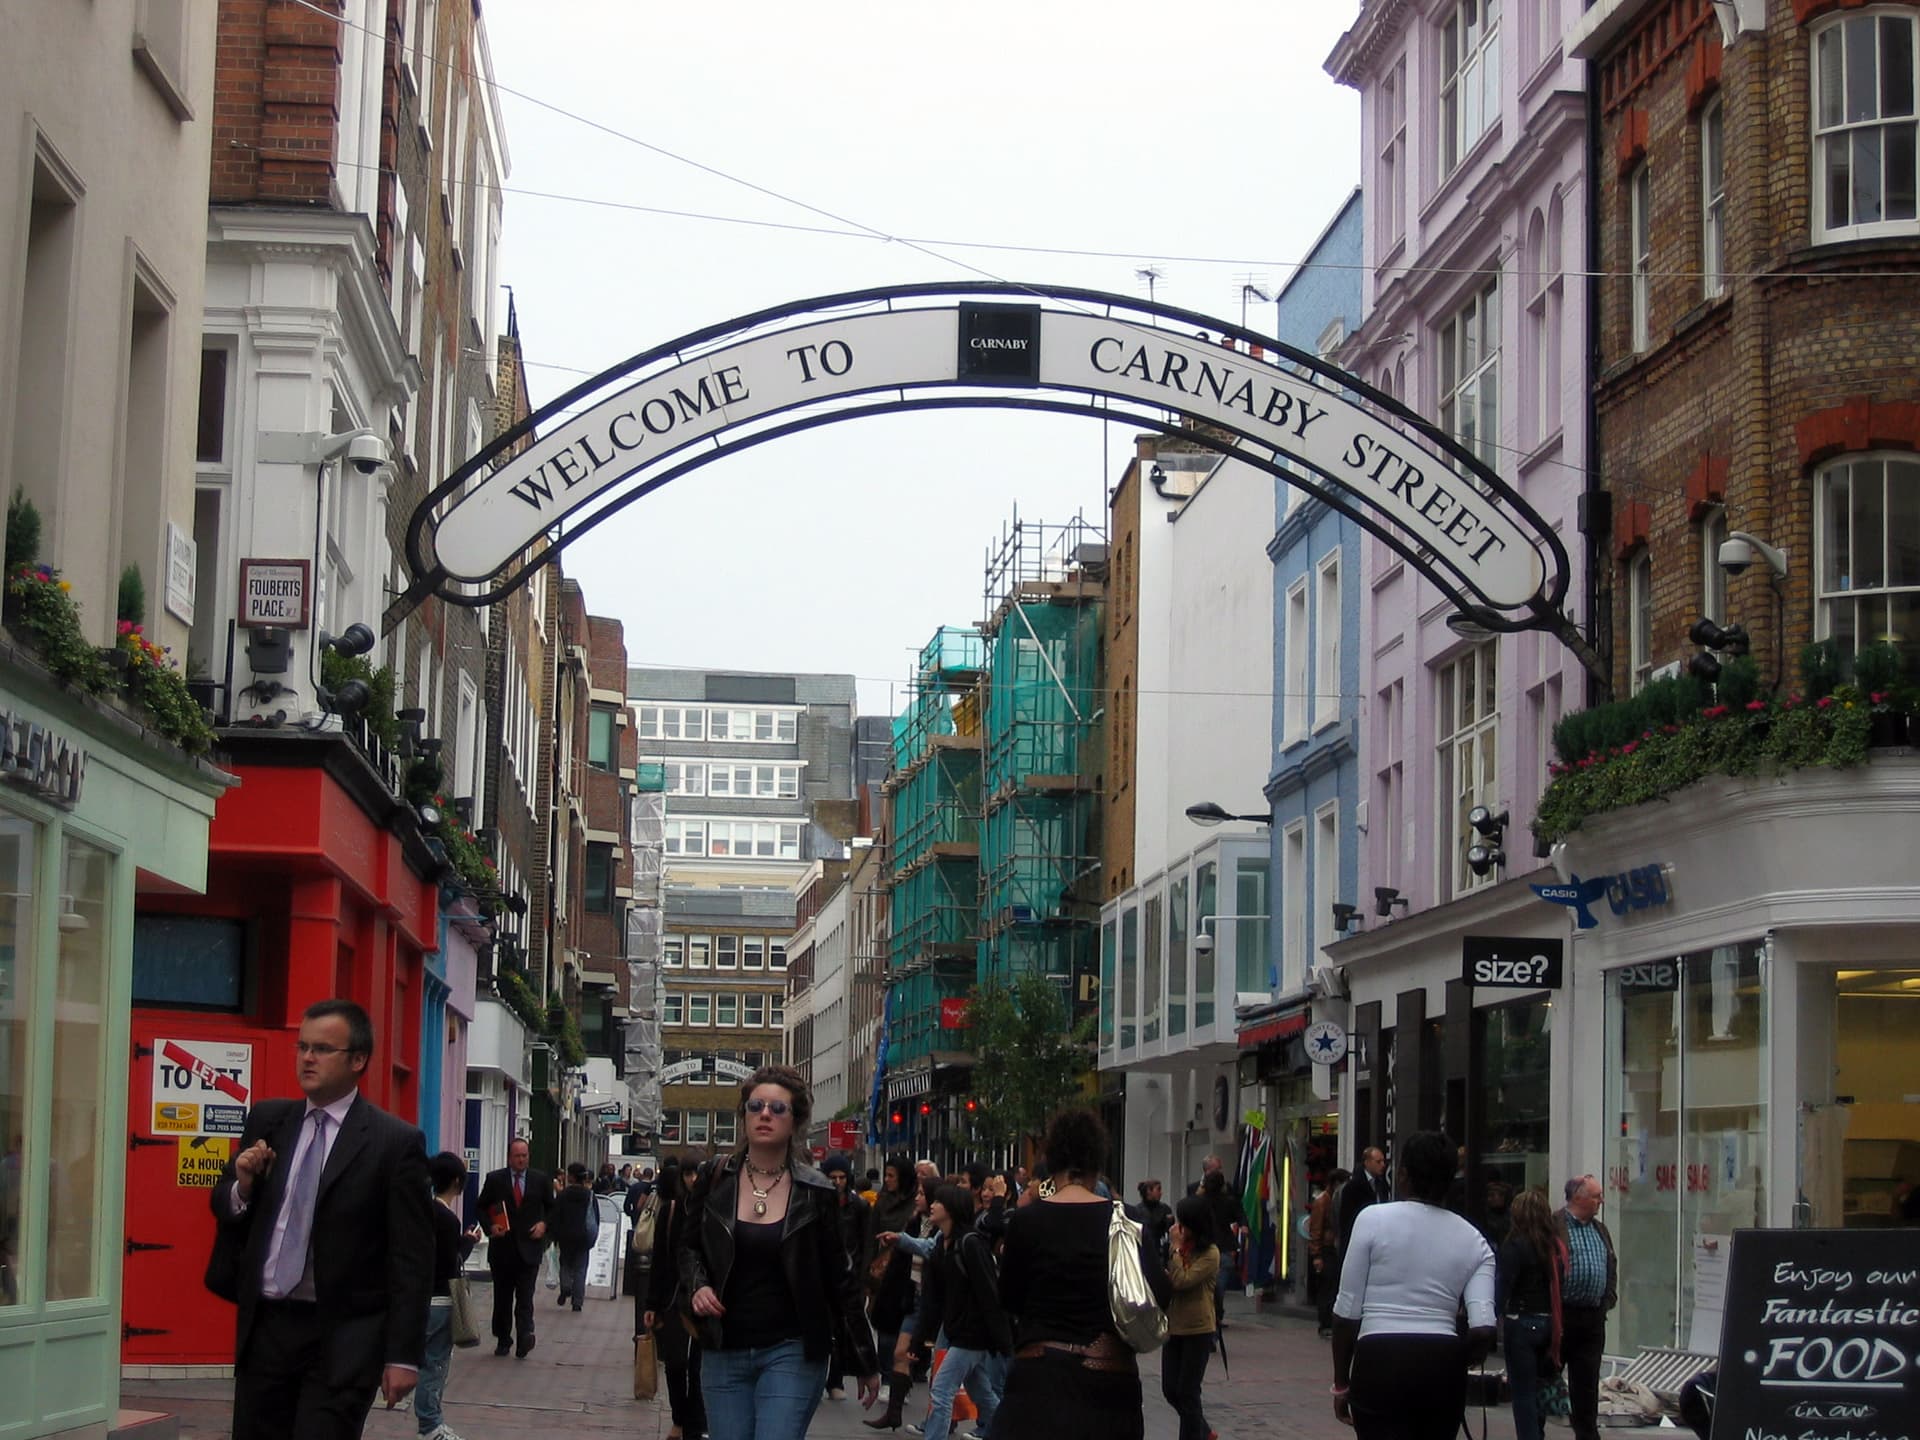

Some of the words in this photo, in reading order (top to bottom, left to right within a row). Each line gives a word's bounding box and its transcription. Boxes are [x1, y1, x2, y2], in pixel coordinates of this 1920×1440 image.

[969, 337, 1029, 350] CARNABY
[507, 365, 750, 511] WELCOME
[786, 340, 854, 383] TO
[1089, 336, 1329, 440] CARNABY
[1341, 433, 1506, 566] STREET
[252, 600, 285, 617] PLACE
[1541, 888, 1578, 898] CASIO
[1474, 953, 1549, 984] size?
[160, 1064, 193, 1090] TO
[191, 1058, 221, 1085] LET
[686, 1062, 697, 1070] TO
[182, 1157, 195, 1169] 24
[179, 1173, 220, 1186] SECURIT
[1687, 1164, 1709, 1192] SALE
[1773, 1261, 1853, 1291] Enjoy
[1866, 1269, 1916, 1285] our
[1760, 1298, 1920, 1325] Fantastic
[1763, 1336, 1906, 1380] FOOD
[1794, 1401, 1823, 1418] in
[1828, 1404, 1869, 1418] our
